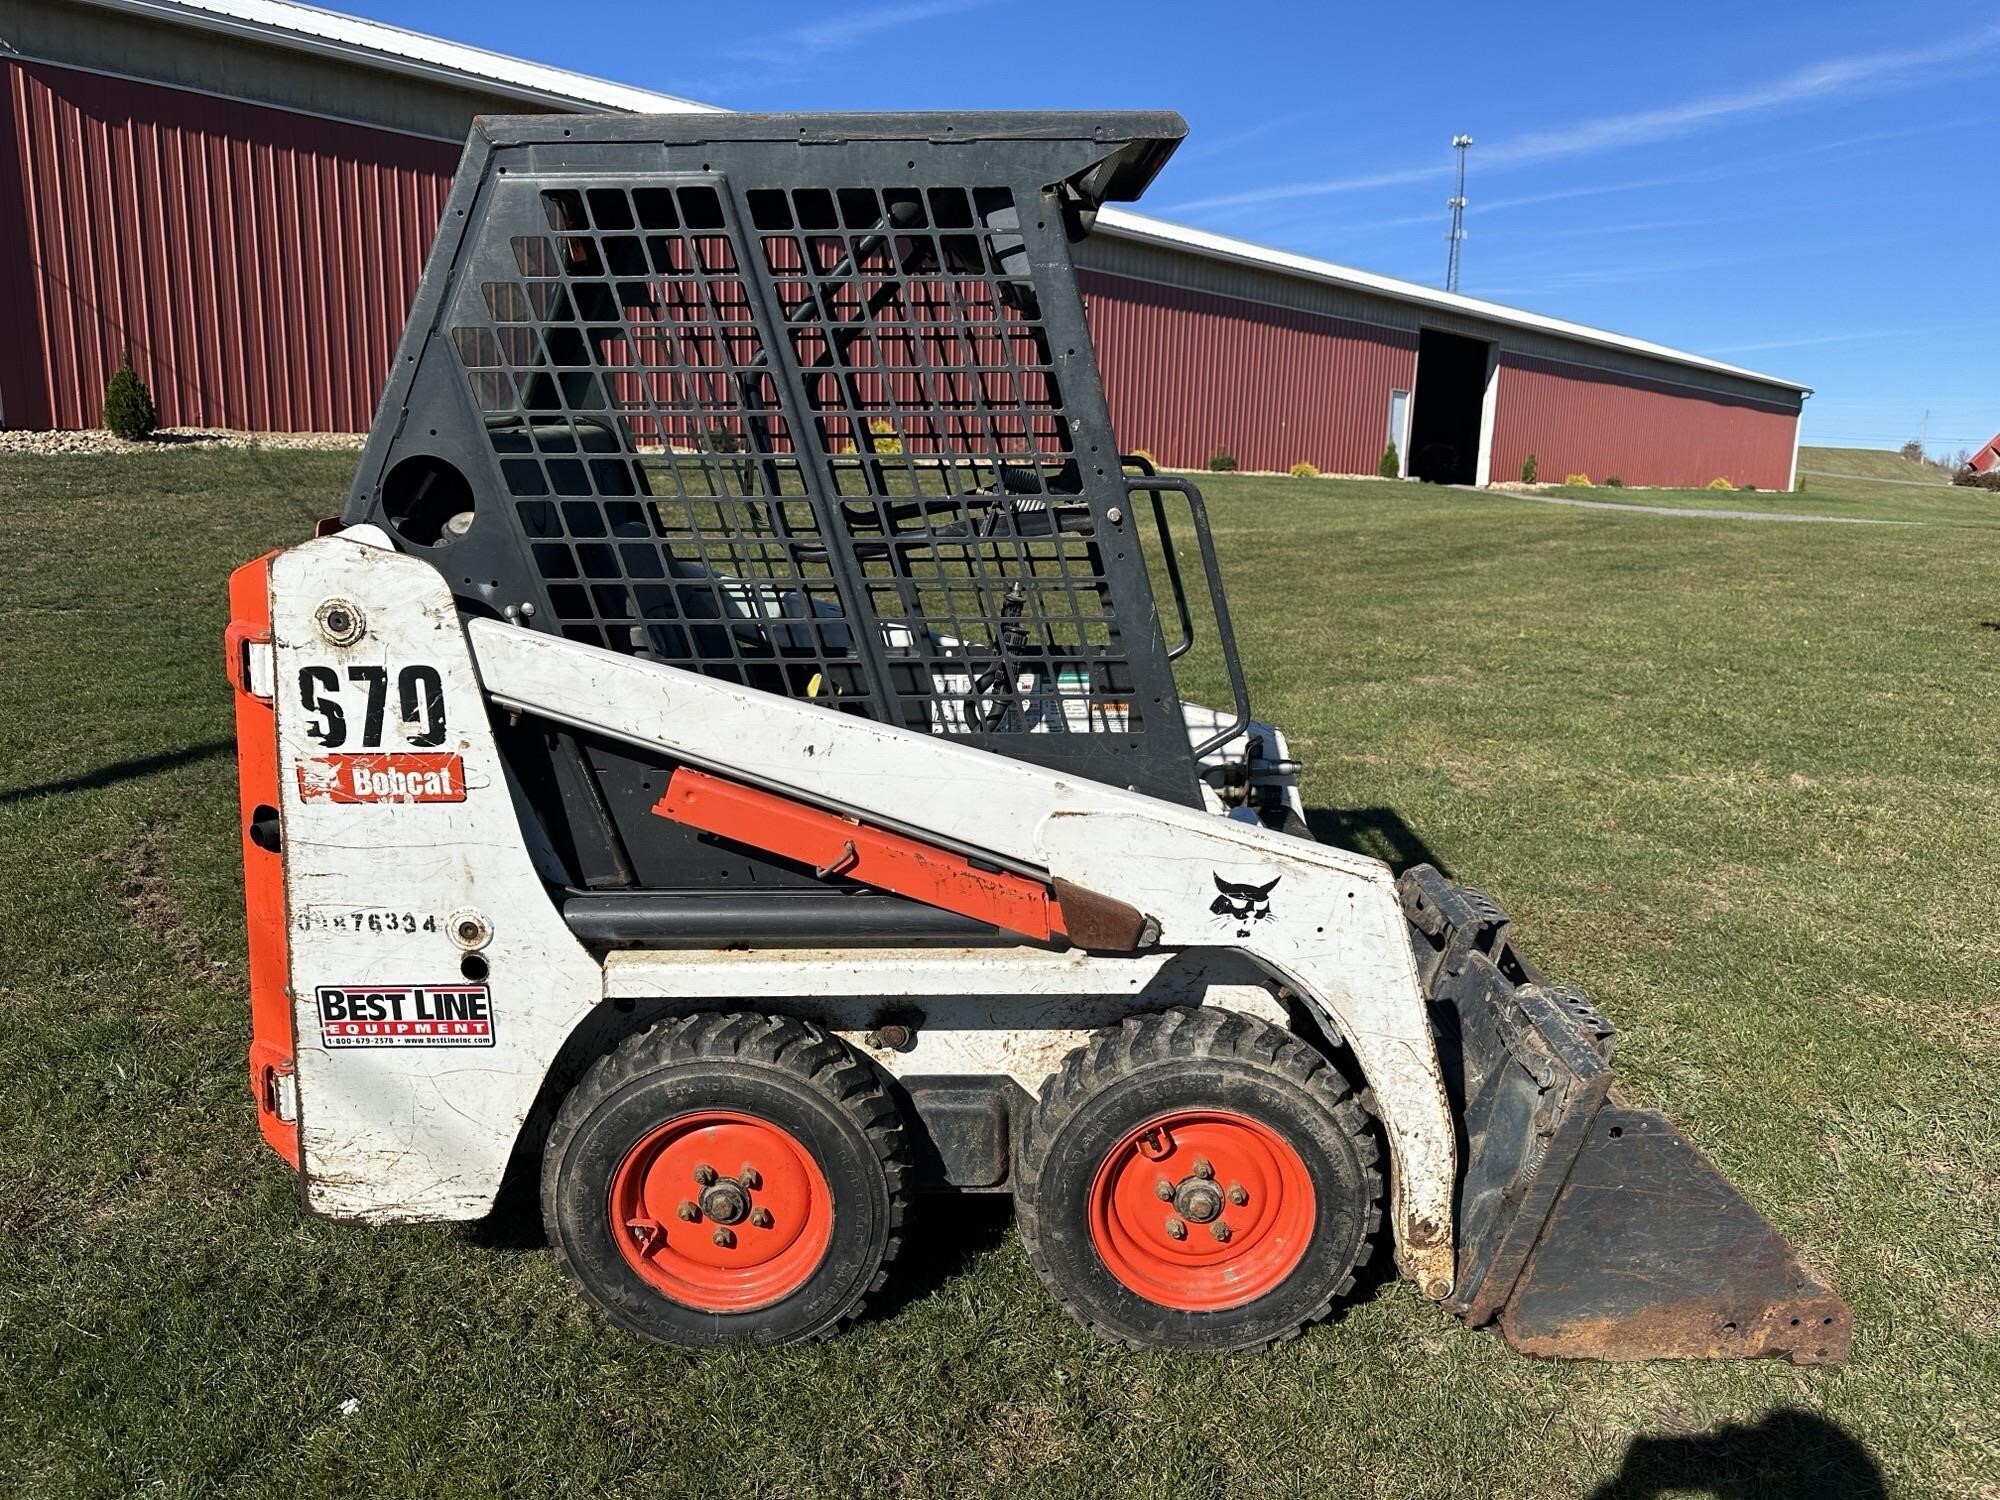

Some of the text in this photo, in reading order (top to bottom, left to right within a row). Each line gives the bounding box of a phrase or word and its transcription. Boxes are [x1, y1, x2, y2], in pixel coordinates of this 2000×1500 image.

[299, 665, 447, 748] S70
[352, 767, 453, 796] Bobcat
[321, 989, 488, 1022] BEST LINE
[329, 1023, 485, 1034] EQUIPMENT
